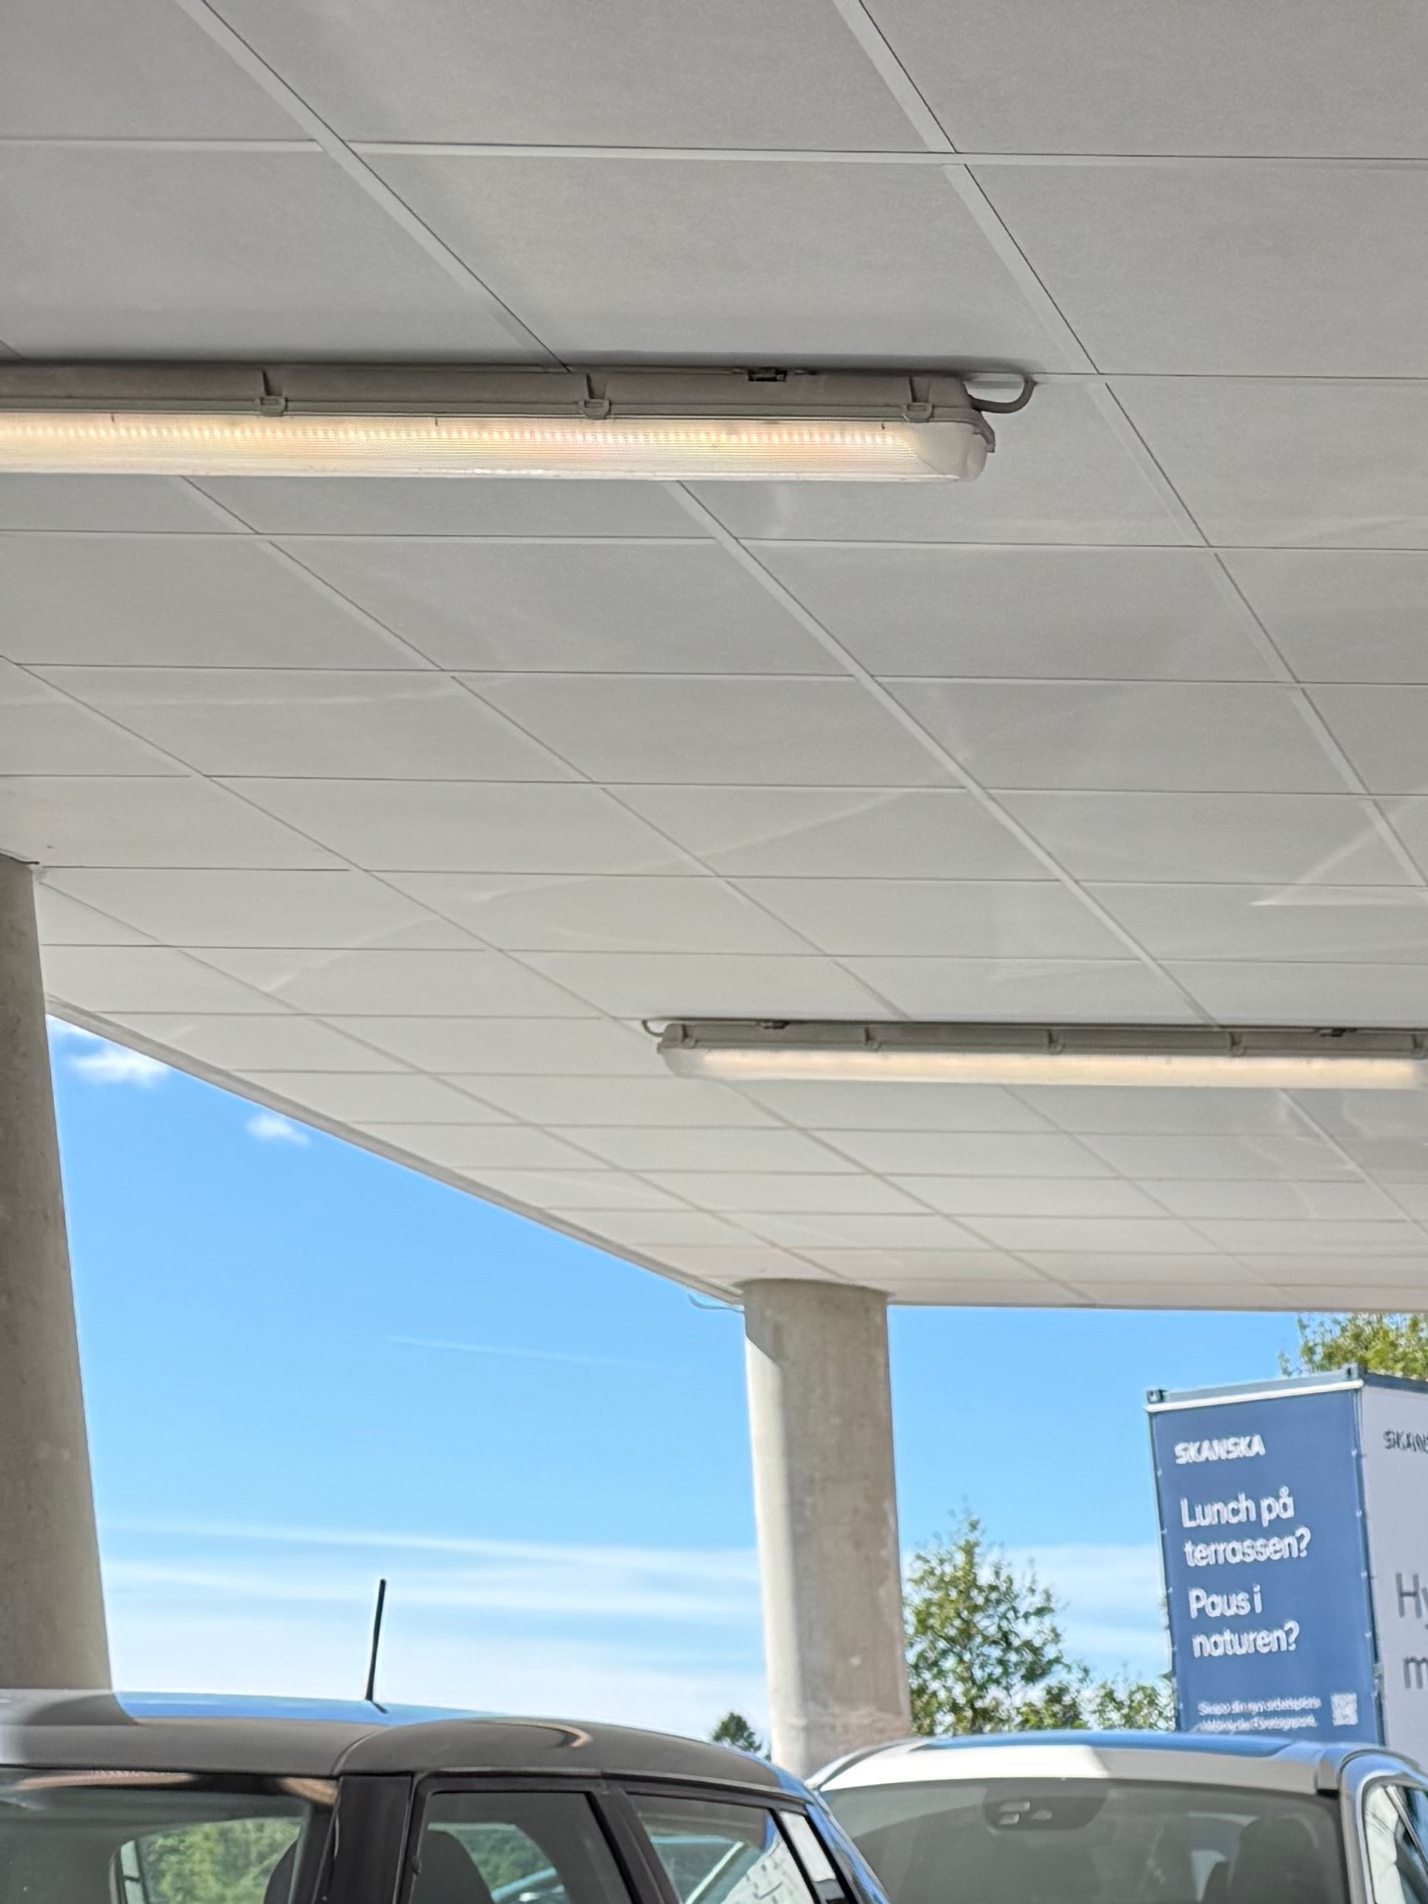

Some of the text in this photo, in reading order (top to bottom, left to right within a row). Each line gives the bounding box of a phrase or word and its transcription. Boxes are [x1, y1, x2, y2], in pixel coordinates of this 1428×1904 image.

[1174, 1434, 1265, 1464] SKANSKA
[1180, 1485, 1294, 1528] Lunch på
[1184, 1527, 1311, 1566] terrassen?
[1189, 1584, 1262, 1619] Paus i
[1192, 1620, 1300, 1658] naturen?
